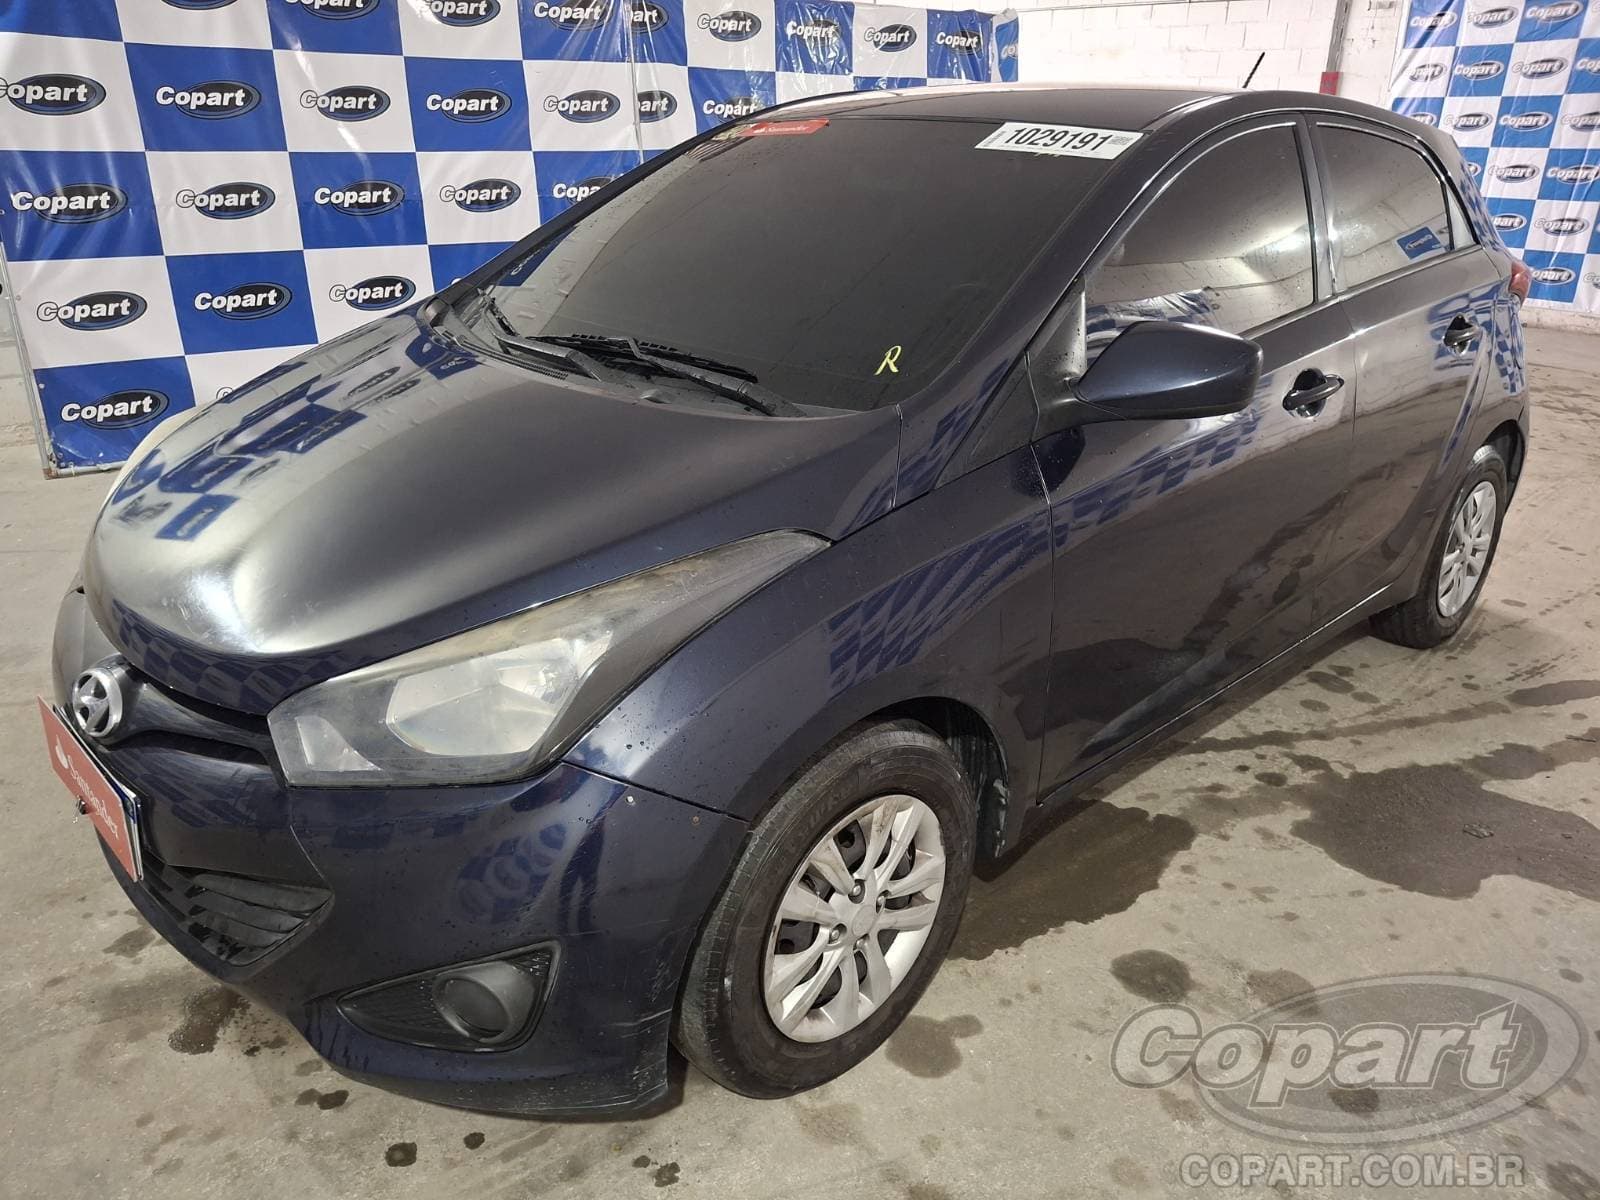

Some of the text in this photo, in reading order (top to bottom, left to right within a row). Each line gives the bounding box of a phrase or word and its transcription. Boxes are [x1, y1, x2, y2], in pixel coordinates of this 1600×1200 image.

[534, 2, 602, 22] Copart
[1526, 2, 1574, 21] Copart
[697, 14, 752, 32] Copart
[787, 20, 834, 39] Copart
[865, 27, 909, 42] Copart
[937, 31, 977, 53] Copart
[1454, 63, 1497, 78] Copart
[1513, 59, 1561, 74] Copart
[155, 86, 245, 108] Copart
[301, 90, 376, 111] Copart
[426, 94, 498, 114] Copart
[544, 96, 608, 115] Copart
[1444, 114, 1486, 128] Copart
[1500, 113, 1546, 128] Copart
[1005, 127, 1113, 151] 1029191
[1489, 165, 1533, 179] Copart
[11, 191, 111, 214] Copart
[176, 189, 261, 213] Copart
[315, 186, 391, 207] Copart
[440, 185, 509, 202] Copart
[1531, 270, 1568, 281] opart
[195, 289, 277, 312] Copart
[329, 283, 402, 302] Copart
[37, 299, 130, 321] Copart
[873, 345, 902, 376] R
[60, 397, 152, 422] Copart
